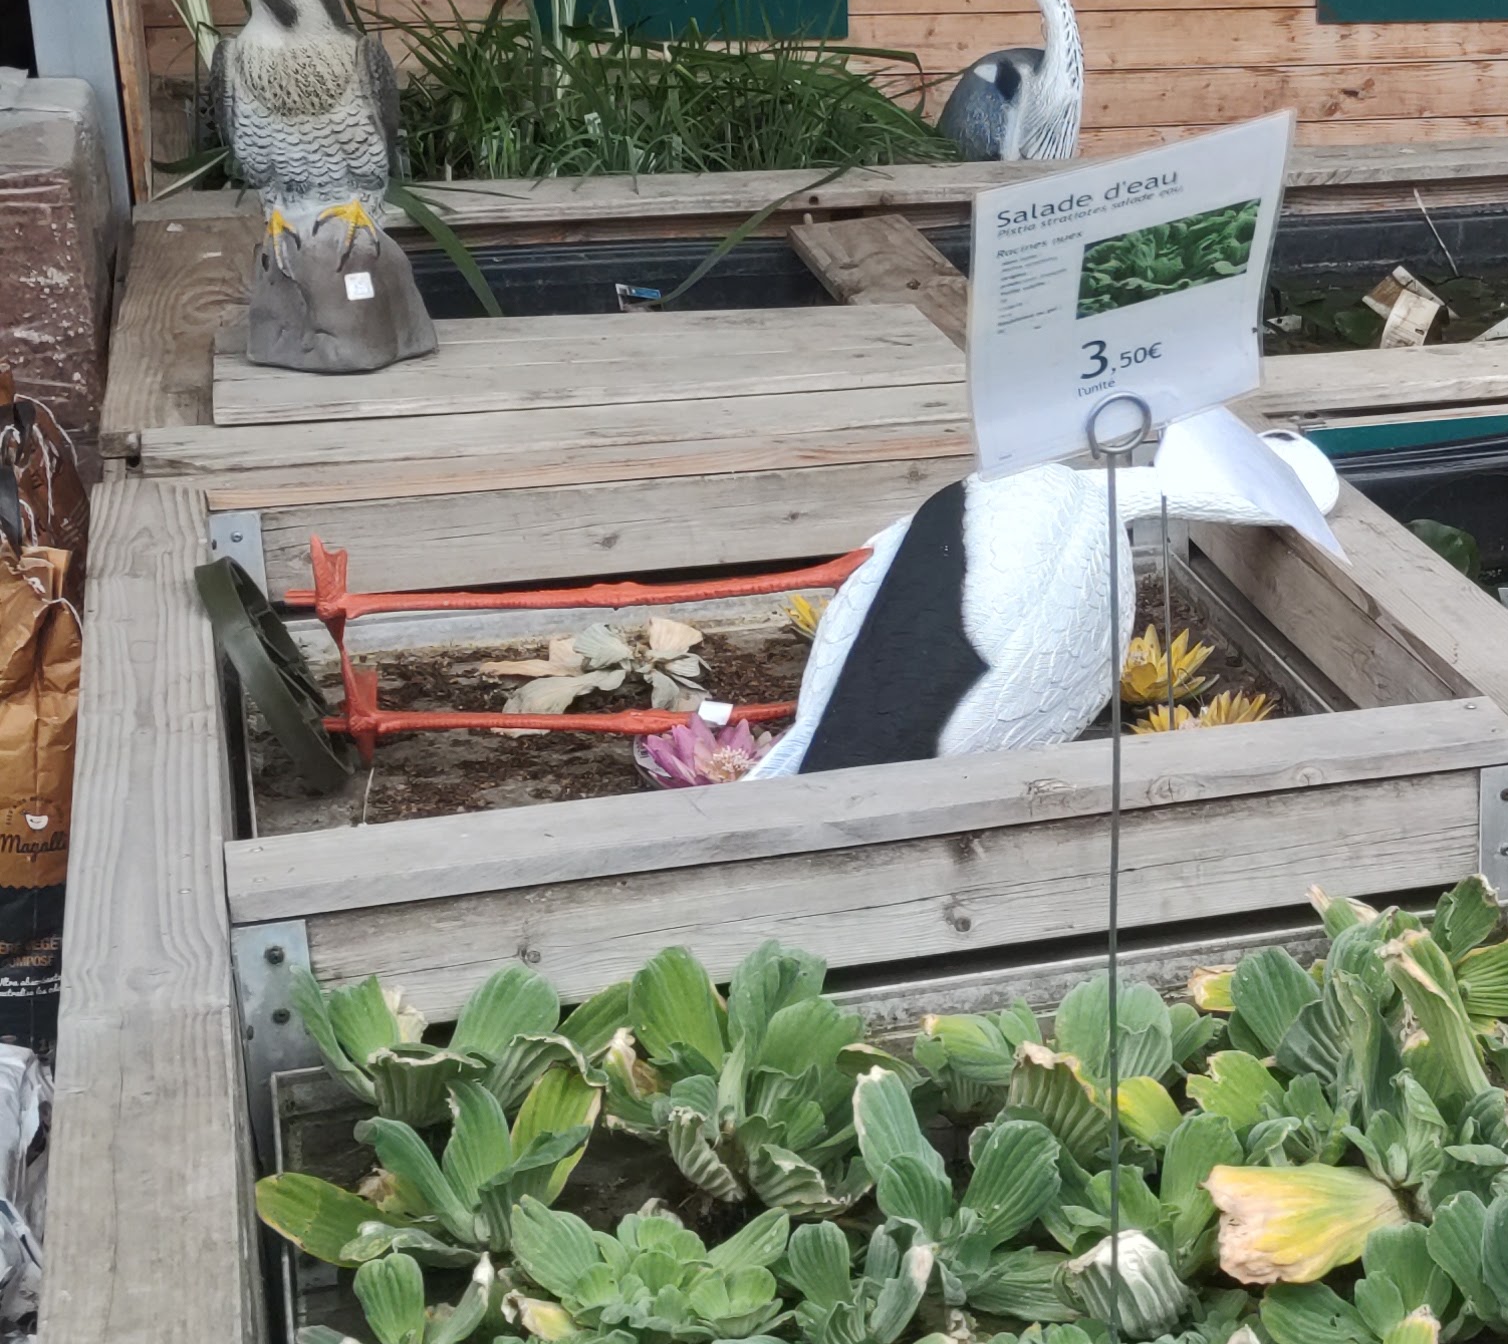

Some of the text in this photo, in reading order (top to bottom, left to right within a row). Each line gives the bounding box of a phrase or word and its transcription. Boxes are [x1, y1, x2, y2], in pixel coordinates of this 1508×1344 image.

[997, 171, 1178, 228] Salade d'eau
[996, 230, 1084, 258] Racines nues
[1080, 340, 1163, 379] 3,50€
[1077, 377, 1116, 397] l'unité
